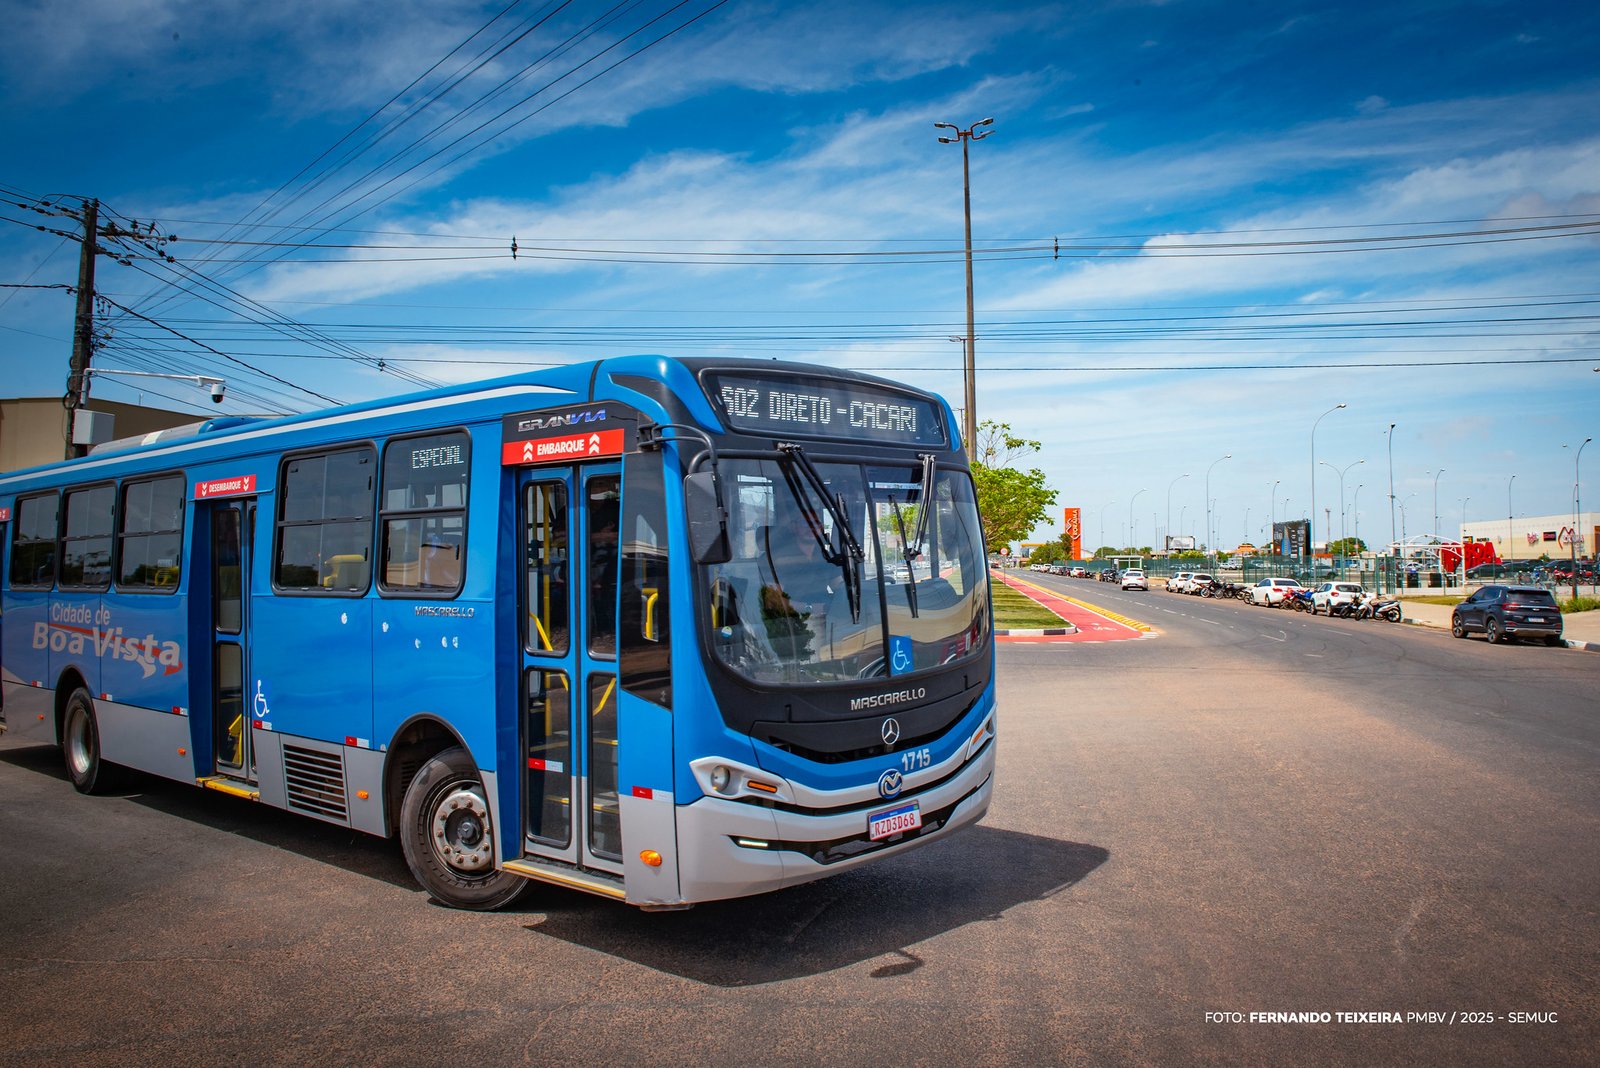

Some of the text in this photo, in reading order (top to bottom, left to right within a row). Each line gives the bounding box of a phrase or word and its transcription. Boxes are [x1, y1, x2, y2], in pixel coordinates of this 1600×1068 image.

[769, 391, 831, 425] DIRETO
[518, 409, 606, 432] GRANVIA
[412, 445, 465, 469] ESPECIAL
[537, 439, 585, 456] EMBARQUE
[209, 480, 242, 493] DESEMBARQUE
[52, 602, 111, 625] Cidade de
[415, 605, 475, 618] MASCARELLO
[32, 622, 181, 667] Boa Vista
[850, 687, 926, 711] MASCARELLO
[901, 748, 931, 772] 1715
[874, 812, 916, 836] RZD3D68
